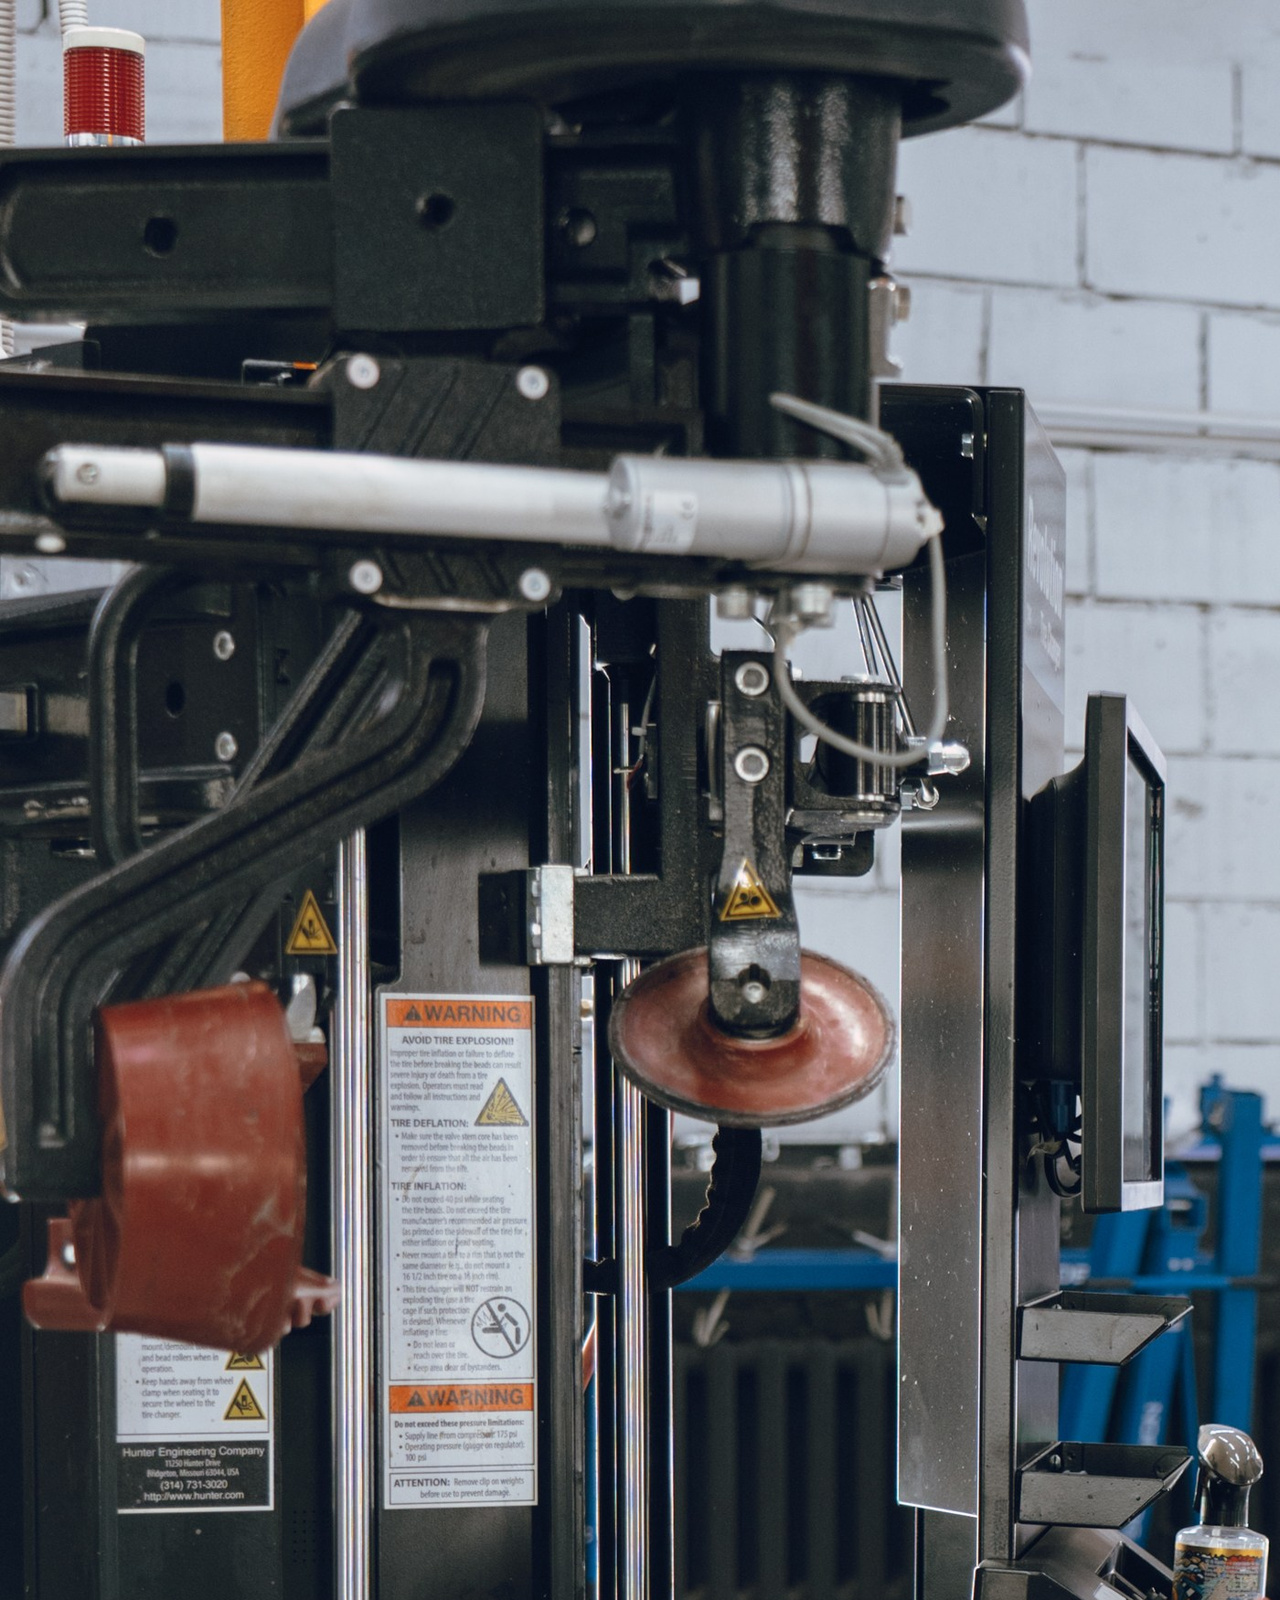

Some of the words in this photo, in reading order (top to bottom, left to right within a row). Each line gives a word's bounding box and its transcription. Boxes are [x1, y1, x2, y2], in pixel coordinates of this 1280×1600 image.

[425, 1005, 522, 1023] WARNING
[401, 1036, 432, 1045] AVOID
[434, 1036, 454, 1045] TIRE
[456, 1036, 515, 1046] EXPLOSION!!
[390, 1050, 418, 1058] Improper
[420, 1050, 430, 1058] tire
[431, 1050, 457, 1058] inflation
[494, 1050, 515, 1058] deflate
[390, 1060, 400, 1068] the
[401, 1060, 413, 1068] tire
[414, 1060, 434, 1068] before
[434, 1061, 460, 1070] breaking
[474, 1061, 492, 1069] beads
[437, 1071, 455, 1079] death
[456, 1071, 471, 1079] from
[422, 1082, 452, 1091] Operators
[470, 1082, 483, 1090] read
[403, 1093, 422, 1101] follow
[423, 1093, 431, 1101] all
[391, 1119, 411, 1128] TIRE
[413, 1119, 469, 1128] DEFLATION:
[433, 1132, 444, 1140] the
[503, 1133, 519, 1141] been
[401, 1143, 428, 1151] removed
[429, 1143, 449, 1151] before
[391, 1182, 412, 1191] TIRE
[413, 1182, 467, 1191] INFLATION:
[489, 1206, 499, 1214] the
[465, 1285, 479, 1293] NOT
[423, 1306, 437, 1314] such
[436, 1317, 467, 1325] Whenever
[141, 1354, 154, 1362] and
[155, 1354, 171, 1362] bead
[172, 1353, 192, 1362] rollers
[194, 1353, 212, 1361] when
[141, 1365, 174, 1374] operation.
[413, 1364, 429, 1373] Keep
[141, 1378, 158, 1387] Keep
[159, 1377, 178, 1385] hands
[179, 1378, 196, 1387] away
[197, 1376, 213, 1385] from
[215, 1377, 234, 1385] wheel
[141, 1389, 161, 1398] clamp
[162, 1389, 181, 1397] when
[182, 1388, 205, 1398] seating
[427, 1388, 524, 1407] WARNING
[164, 1399, 175, 1408] the
[176, 1399, 195, 1407] wheel
[205, 1398, 216, 1407] the
[141, 1411, 153, 1419] tire
[155, 1410, 182, 1421] changer.
[417, 1420, 439, 1428] exceed
[460, 1420, 487, 1429] pressure
[487, 1418, 525, 1426] limitations:
[405, 1432, 425, 1441] Supply
[426, 1431, 438, 1439] line
[497, 1430, 508, 1438] 175
[509, 1430, 518, 1439] psi
[405, 1442, 435, 1452] Operating
[436, 1442, 462, 1451] pressure
[122, 1448, 156, 1458] Hunter
[158, 1446, 217, 1458] Engineering
[219, 1446, 265, 1457] Company
[417, 1453, 427, 1462] psi
[184, 1459, 204, 1467] Hunter
[205, 1459, 221, 1467] Drive
[227, 1468, 240, 1476] USA
[160, 1480, 184, 1491] (314)
[187, 1479, 228, 1489] 731-3020
[394, 1478, 450, 1487] ATTENTION:
[454, 1478, 479, 1486] Remove
[480, 1477, 491, 1486] clip
[500, 1477, 525, 1486] weights
[143, 1491, 245, 1503] http://www.hunter.com
[420, 1490, 440, 1498] before
[461, 1490, 484, 1499] prevent
